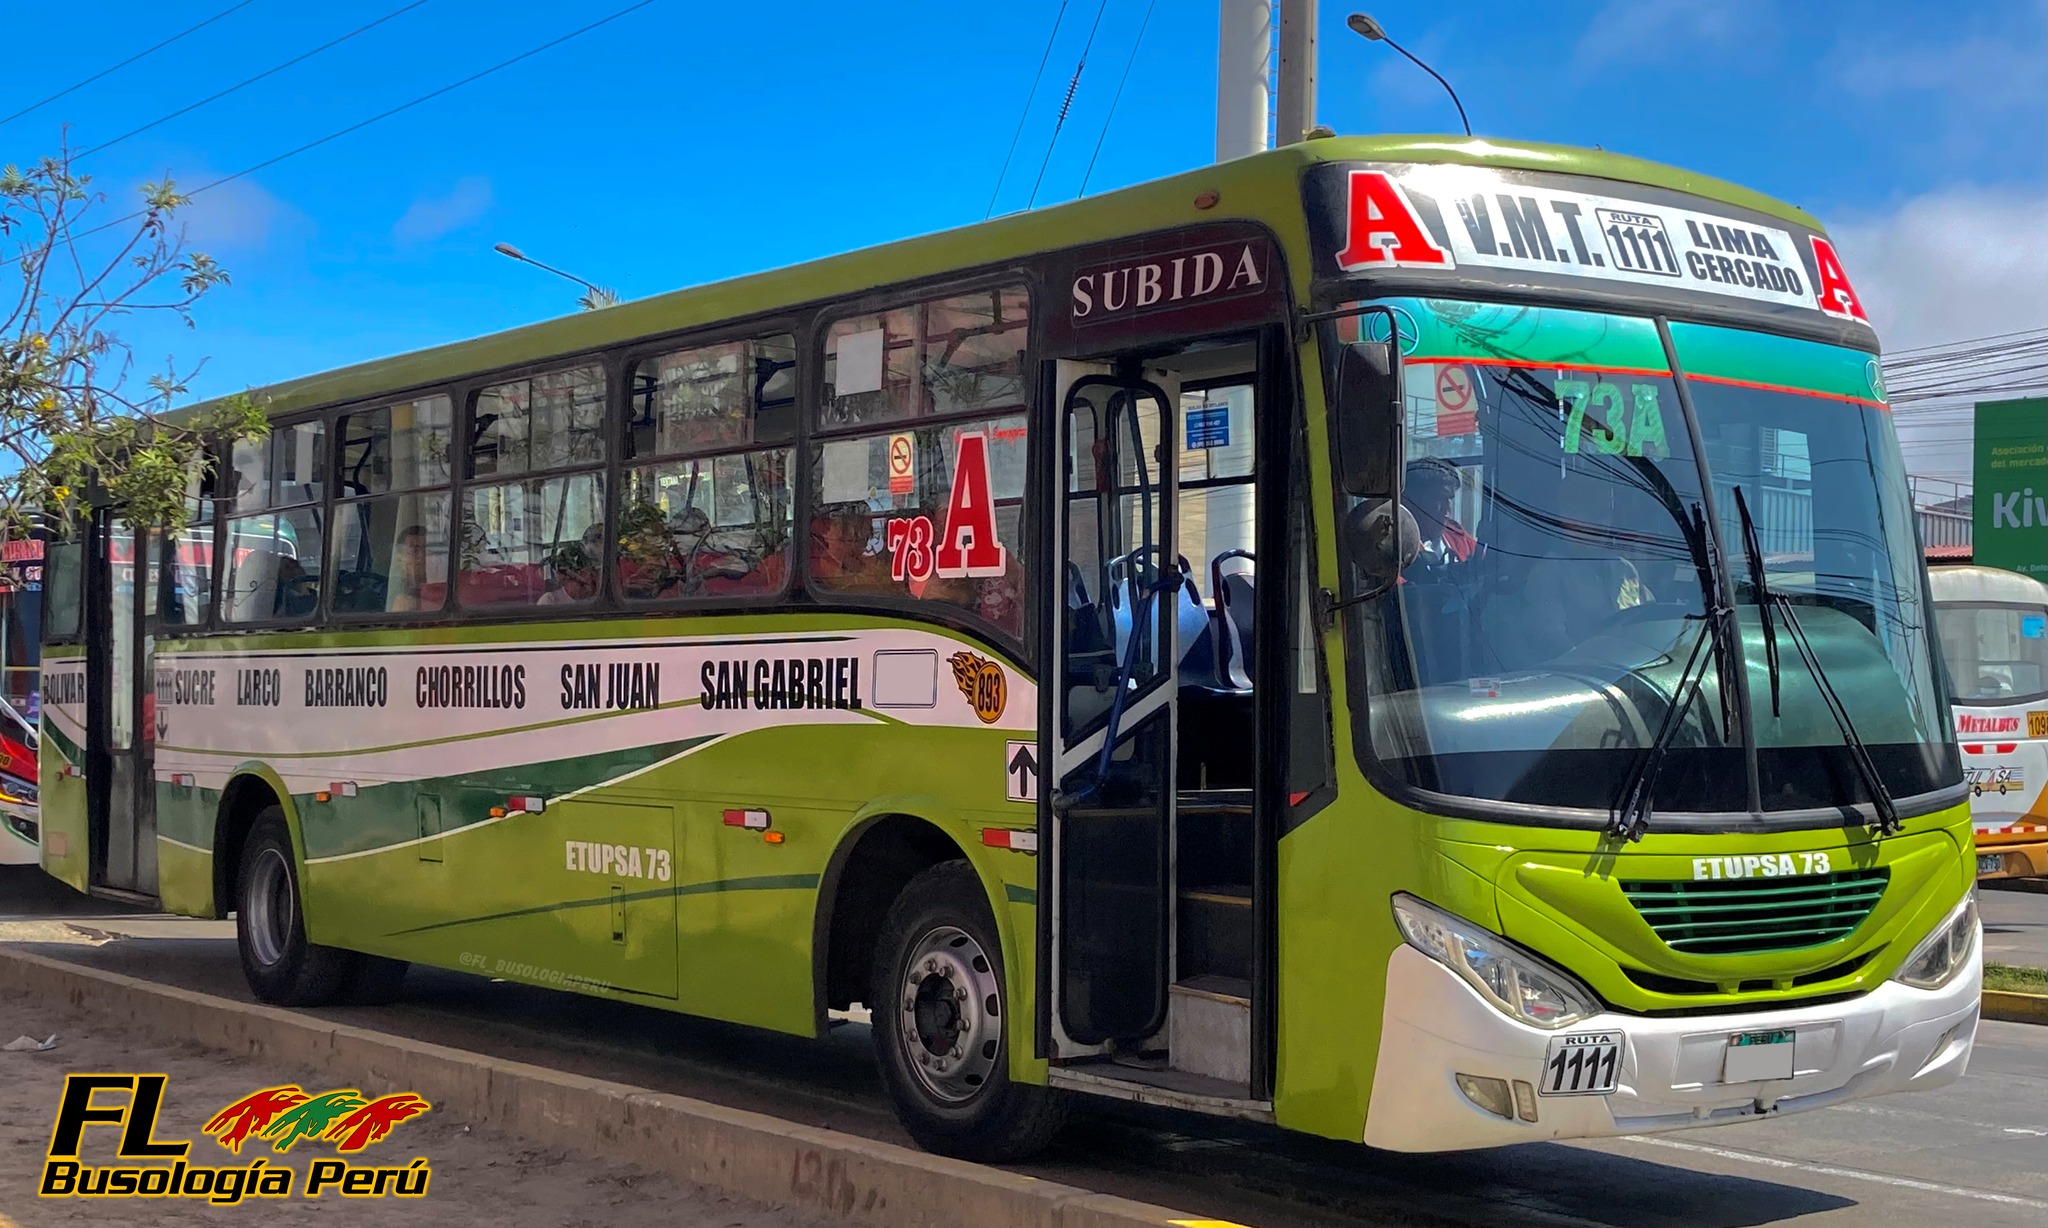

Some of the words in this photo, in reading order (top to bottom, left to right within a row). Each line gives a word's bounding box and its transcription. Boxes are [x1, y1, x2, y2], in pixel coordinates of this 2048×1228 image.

[1336, 169, 1456, 271] A
[1455, 193, 1606, 267] V.M.T.
[1610, 212, 1653, 226] RUTA
[1685, 219, 1780, 261] LIMA
[1606, 224, 1678, 273] 1111
[1072, 245, 1262, 318] SUBIDA
[1685, 250, 1804, 296] CERCADO
[1808, 234, 1871, 325] A
[1554, 379, 1670, 458] 73A
[1991, 444, 2044, 456] Asociación
[1991, 459, 2006, 469] del
[2009, 457, 2048, 468] mercad
[887, 515, 934, 582] 73
[935, 431, 1006, 578] A
[43, 672, 85, 705] BOLIVAR
[175, 669, 215, 706] SUCRE
[237, 668, 281, 707] LARCO
[304, 665, 388, 708] BARRANCO
[415, 664, 526, 709] CHORRILLOS
[560, 663, 602, 710] SAN
[606, 662, 660, 710] JUAN
[700, 660, 748, 710] SAN
[753, 657, 863, 710] GABRIEL
[977, 672, 1001, 713] 893
[1956, 714, 2020, 734] METALBUS
[2029, 715, 2048, 736] 109
[565, 840, 642, 878] ETUPSA
[645, 848, 671, 881] 73
[1692, 854, 1797, 881] ETUPSA
[1799, 852, 1831, 875] 73
[1565, 1035, 1611, 1045] RUTA
[1550, 1046, 1617, 1091] 1111
